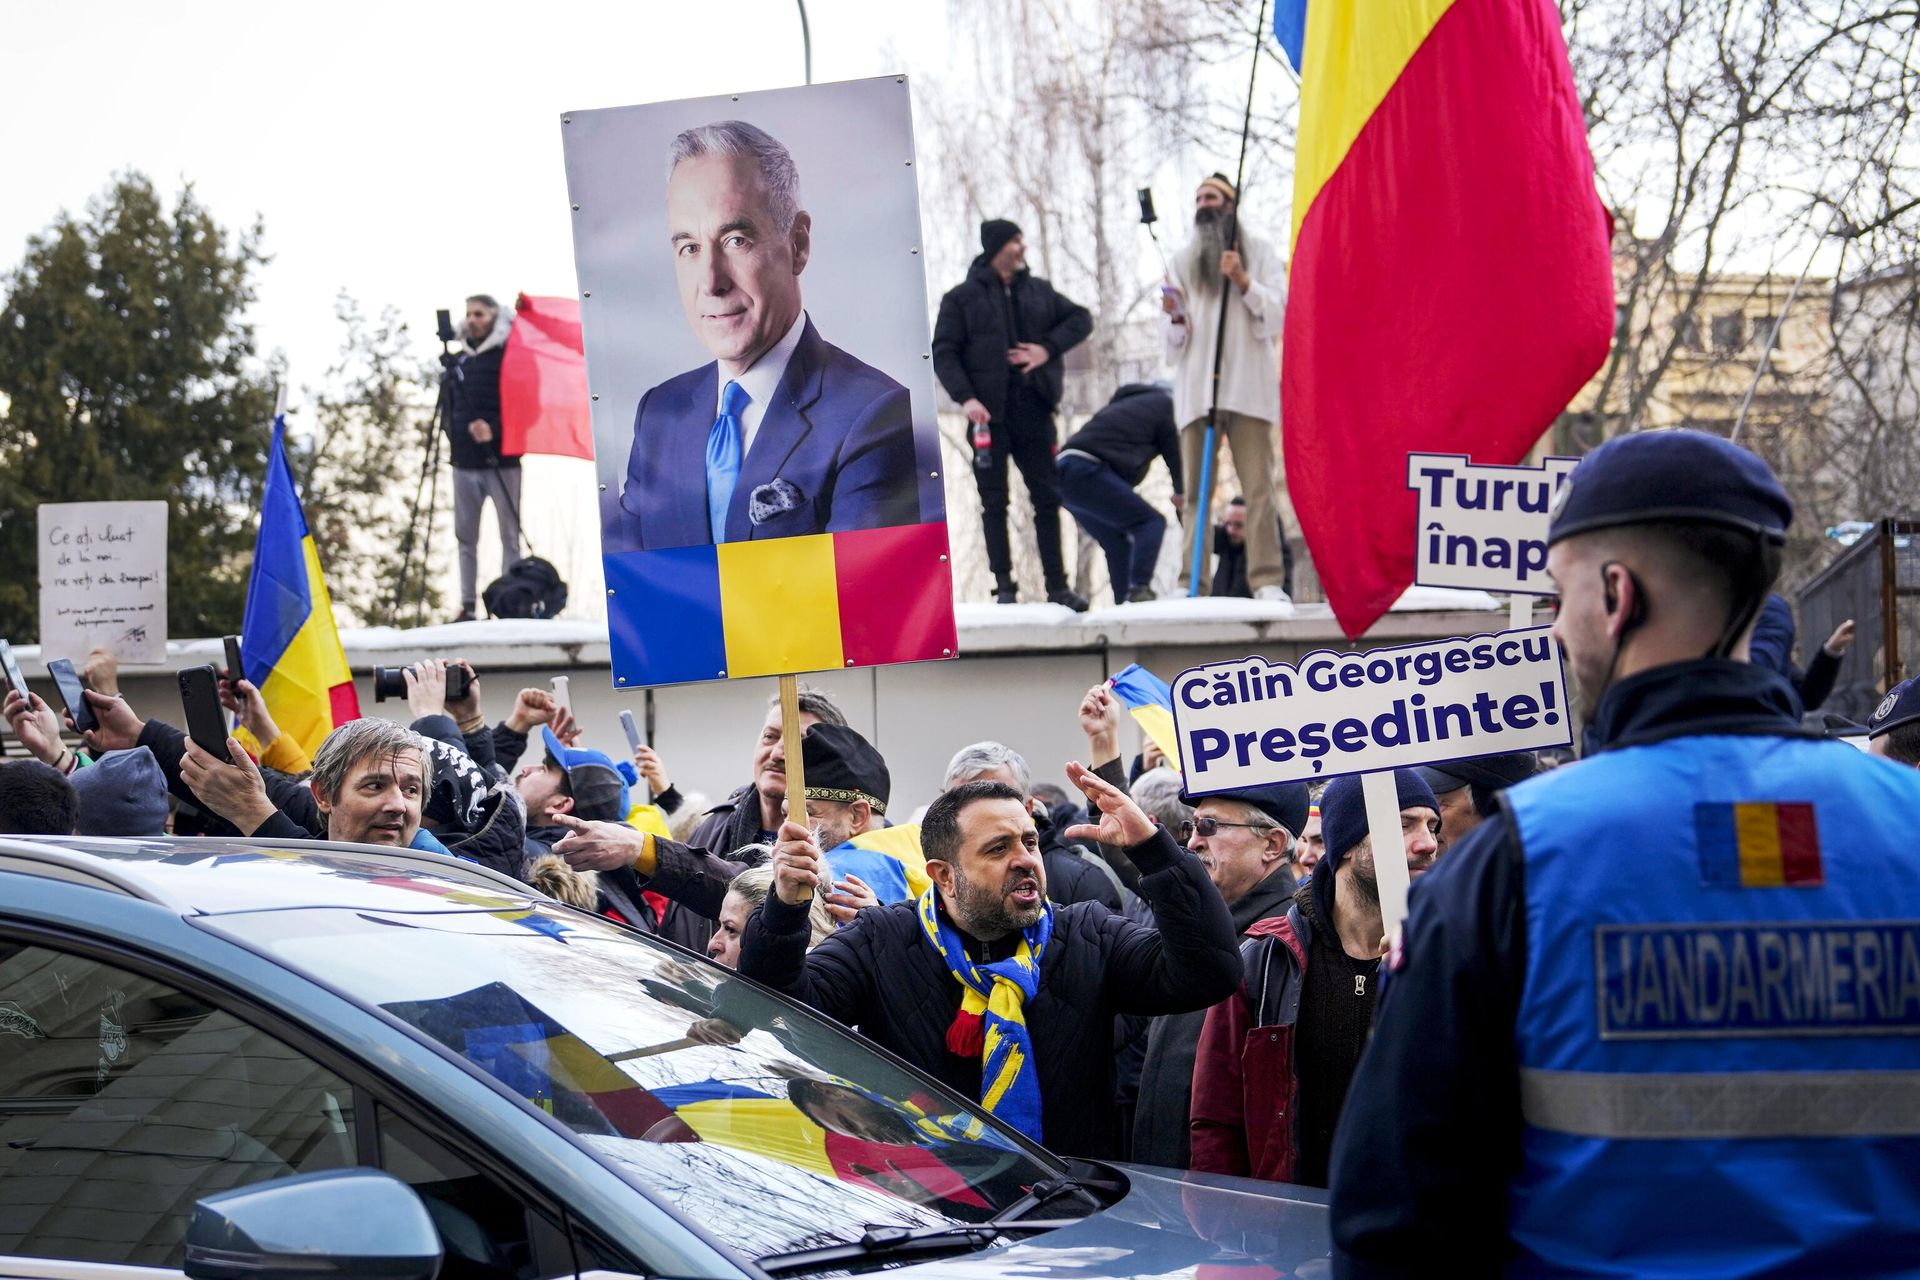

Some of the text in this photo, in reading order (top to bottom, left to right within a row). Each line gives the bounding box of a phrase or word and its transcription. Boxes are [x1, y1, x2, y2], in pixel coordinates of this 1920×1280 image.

[49, 525, 70, 546] Ce
[58, 552, 71, 565] de
[1181, 636, 1551, 709] Călin Georgescu
[1190, 681, 1560, 773] Președinte!
